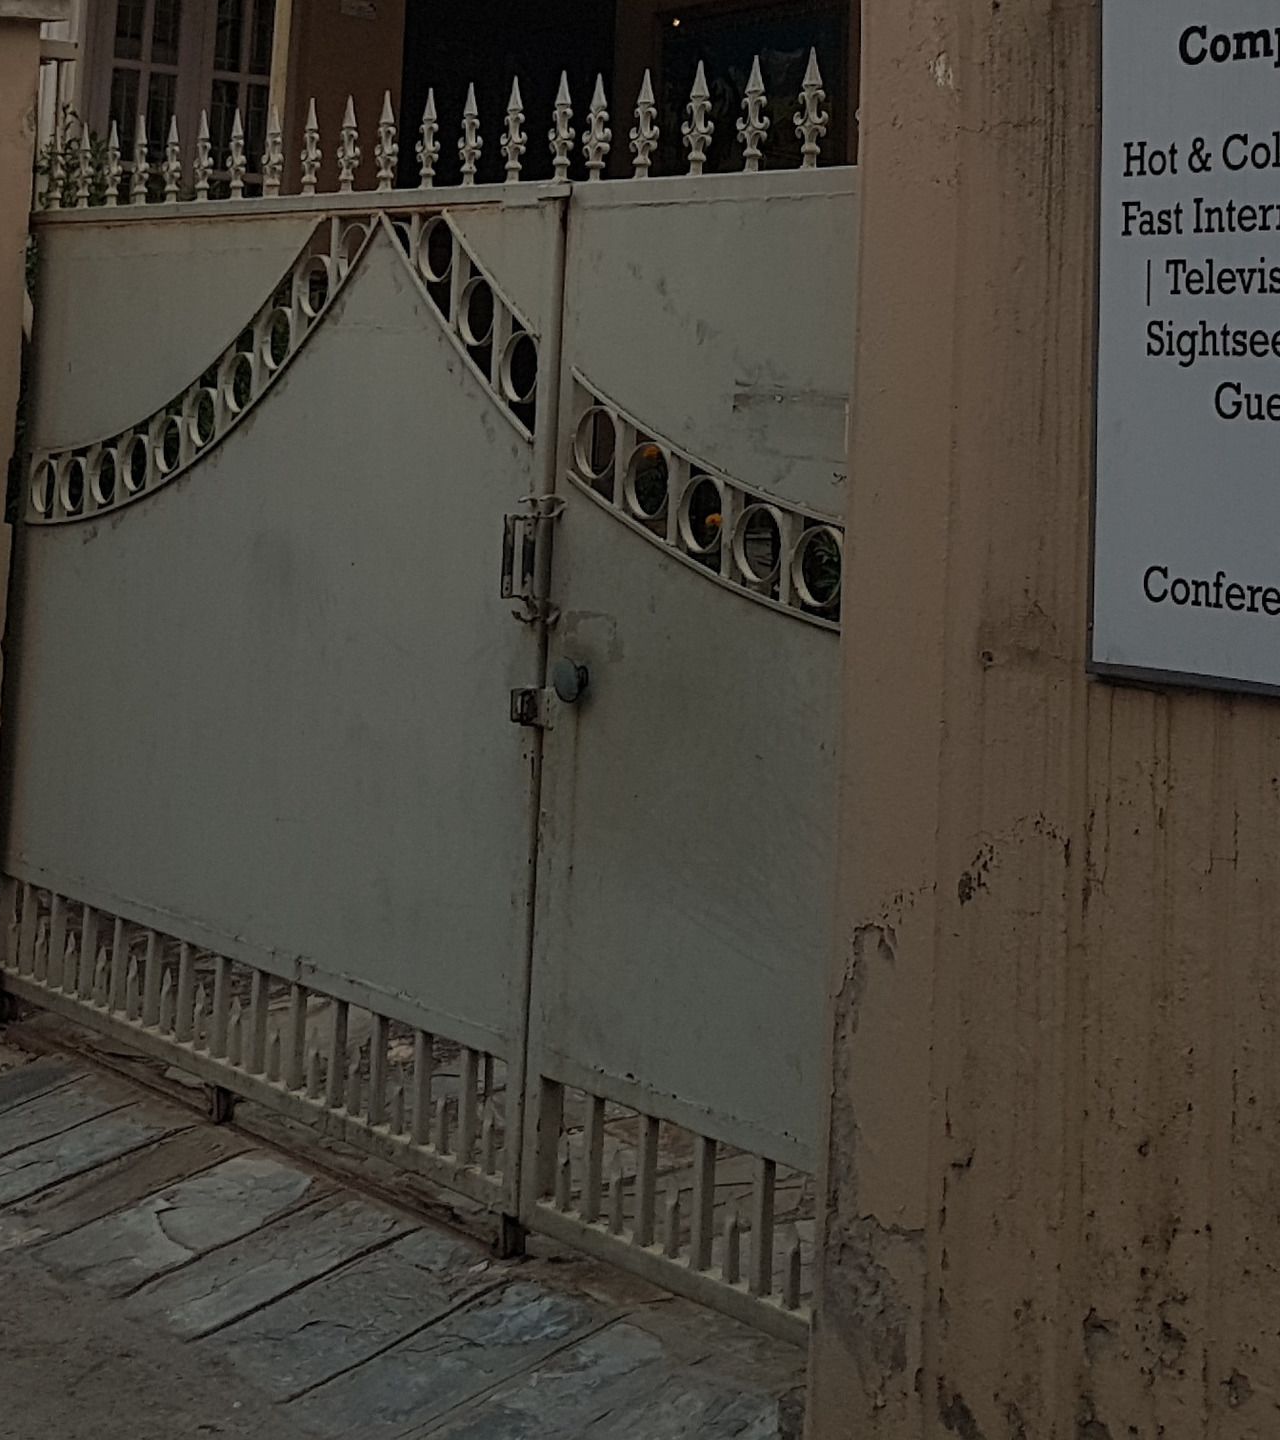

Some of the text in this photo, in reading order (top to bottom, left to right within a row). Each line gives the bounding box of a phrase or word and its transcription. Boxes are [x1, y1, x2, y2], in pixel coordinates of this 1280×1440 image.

[1123, 140, 1178, 177] Hot
[1188, 137, 1212, 173] &
[1121, 200, 1183, 236] Fast
